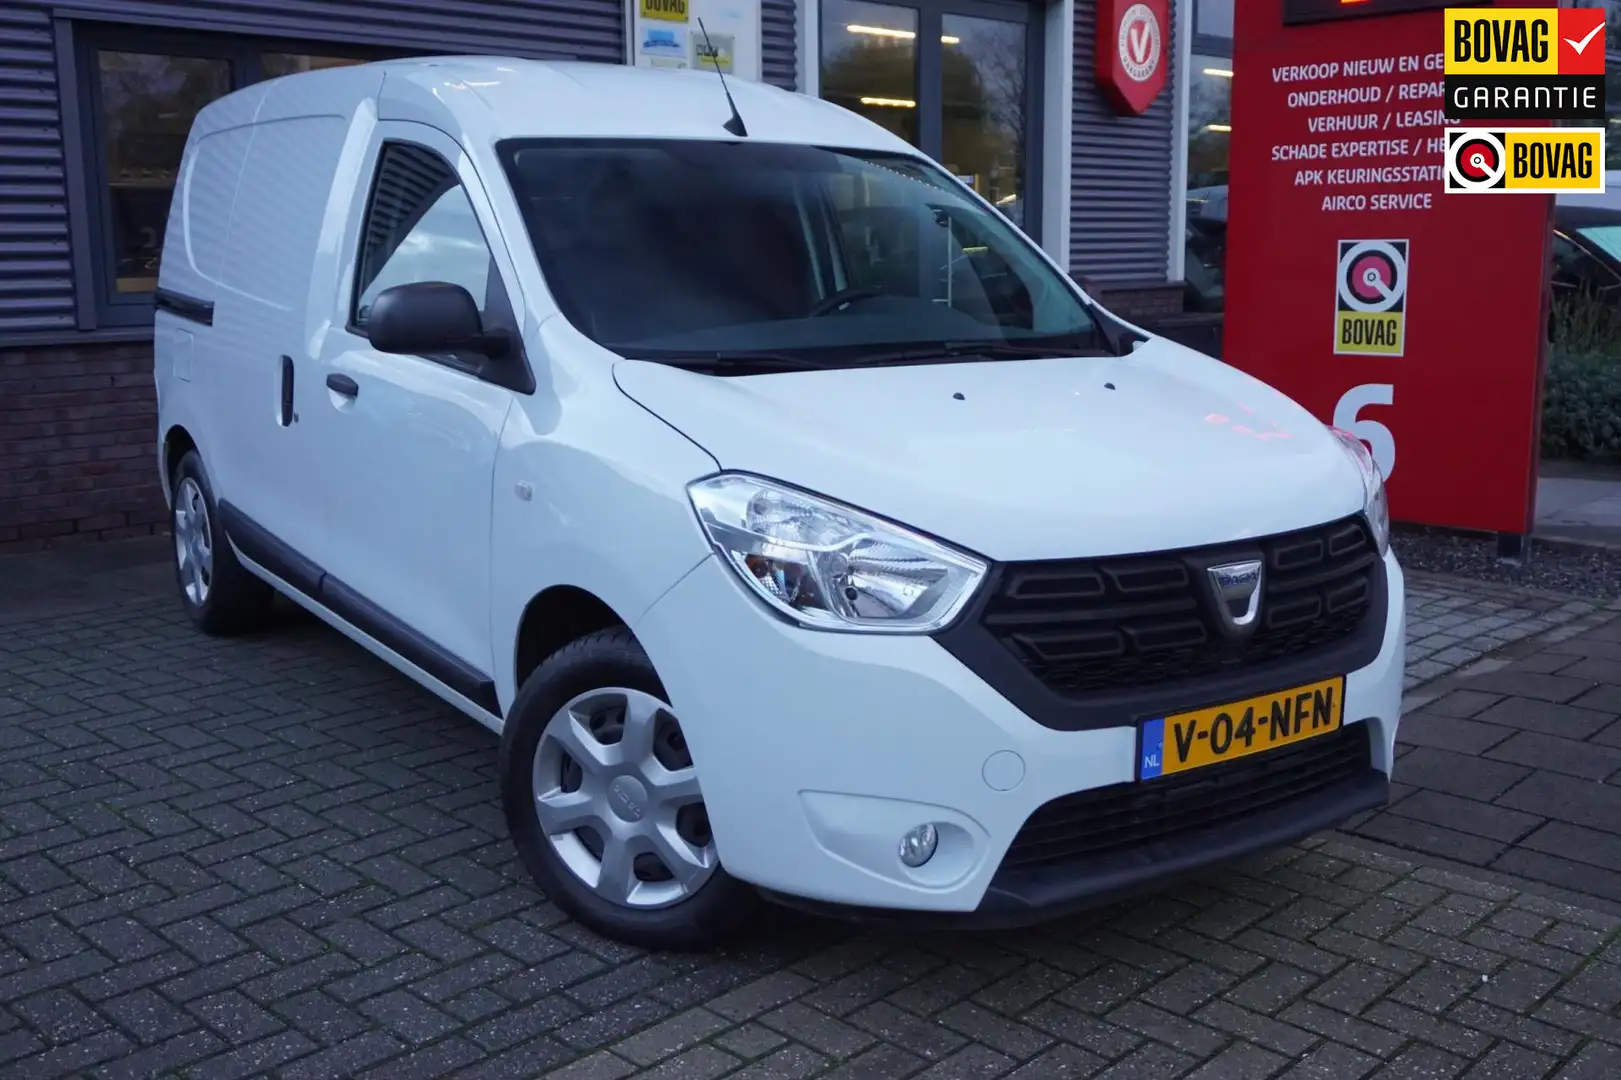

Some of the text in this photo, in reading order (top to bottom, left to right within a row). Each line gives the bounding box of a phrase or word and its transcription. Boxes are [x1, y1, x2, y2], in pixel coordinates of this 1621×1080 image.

[1272, 62, 1339, 83] VERKOOP
[1343, 57, 1395, 77] NIEUW
[1399, 55, 1419, 72] EN
[1287, 86, 1381, 108] ONDERHOUD
[1385, 85, 1394, 103] /
[1308, 113, 1378, 132] VERHUUR
[1382, 112, 1392, 130] /
[1271, 143, 1327, 161] SCHADE
[1331, 139, 1409, 158] EXPERTISE
[1412, 138, 1422, 156] /
[1294, 165, 1445, 186] APK KEURINGSSTATI
[1322, 193, 1432, 212] AIRCO SERVICE
[1341, 318, 1397, 346] BOVAG
[1332, 383, 1396, 483] 6
[1174, 686, 1334, 763] V-04-NFN
[1144, 754, 1160, 769] NL
